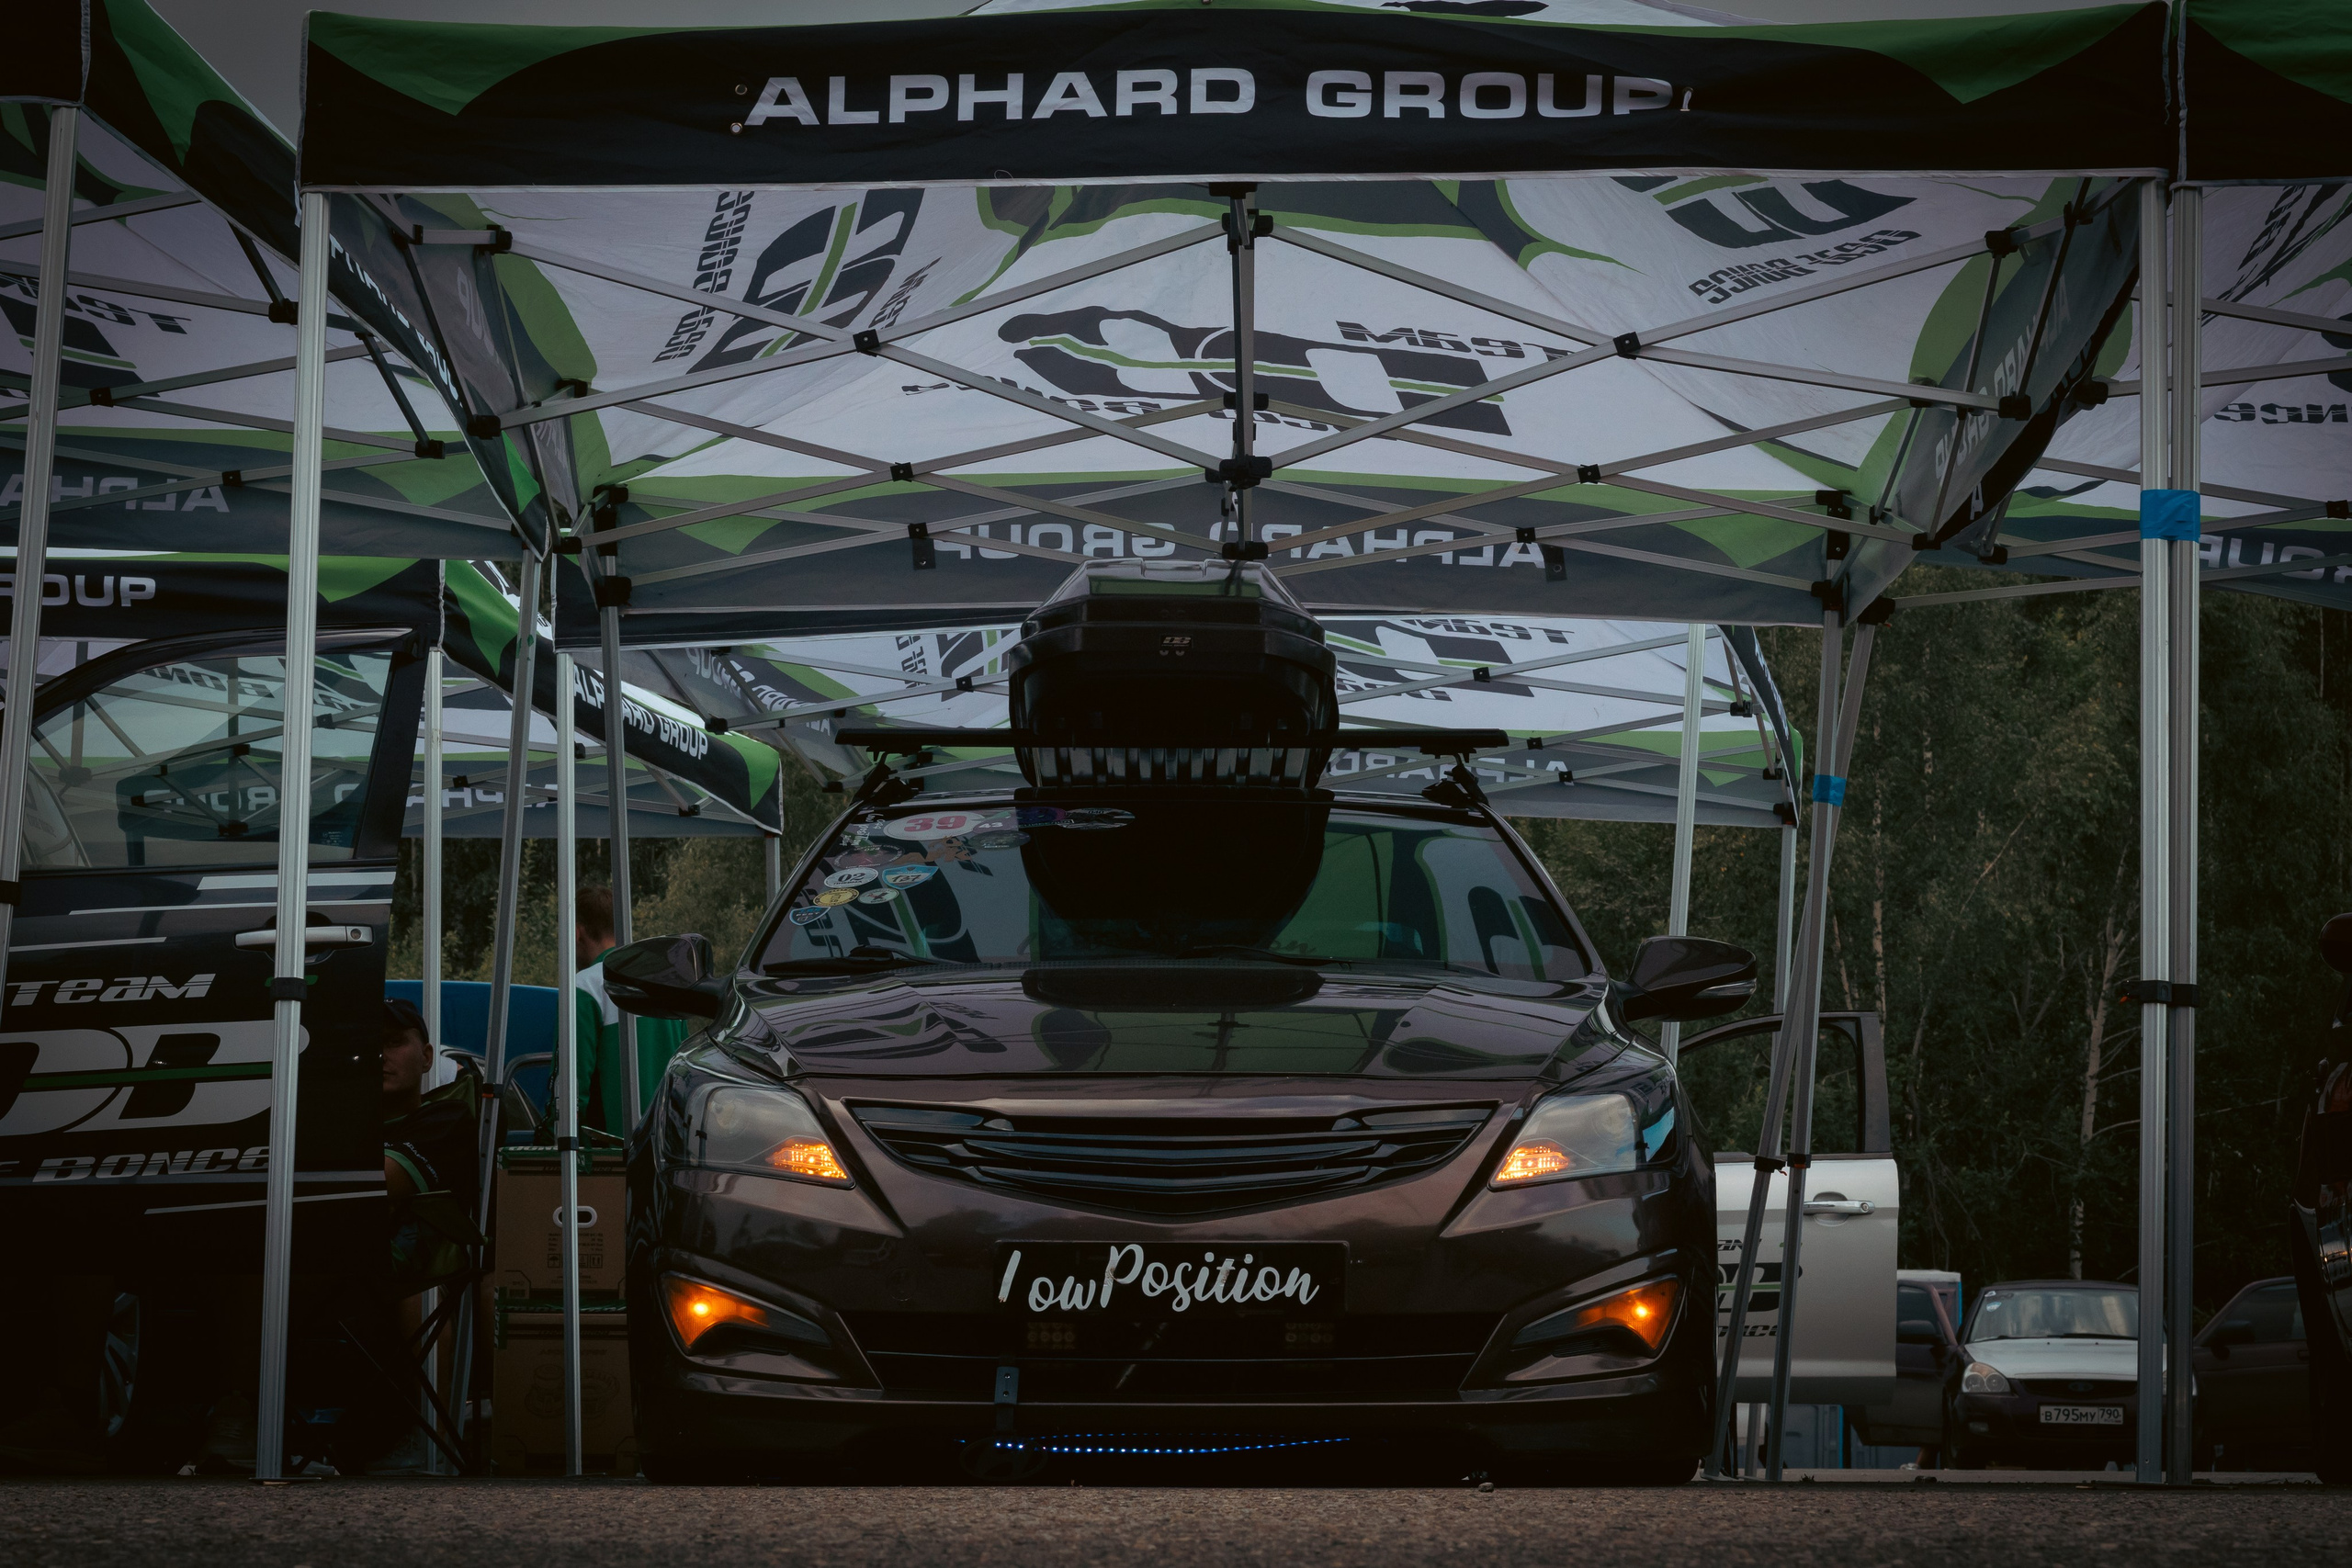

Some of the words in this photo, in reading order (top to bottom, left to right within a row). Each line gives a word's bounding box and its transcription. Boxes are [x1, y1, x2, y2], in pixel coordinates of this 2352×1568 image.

[747, 68, 1256, 126] ALPHARD
[1306, 70, 1673, 118] GROUP
[659, 712, 708, 760] GROUP
[903, 815, 968, 833] 39
[837, 872, 866, 883] 02
[891, 874, 922, 883] 137
[2099, 1407, 2120, 1419] 790
